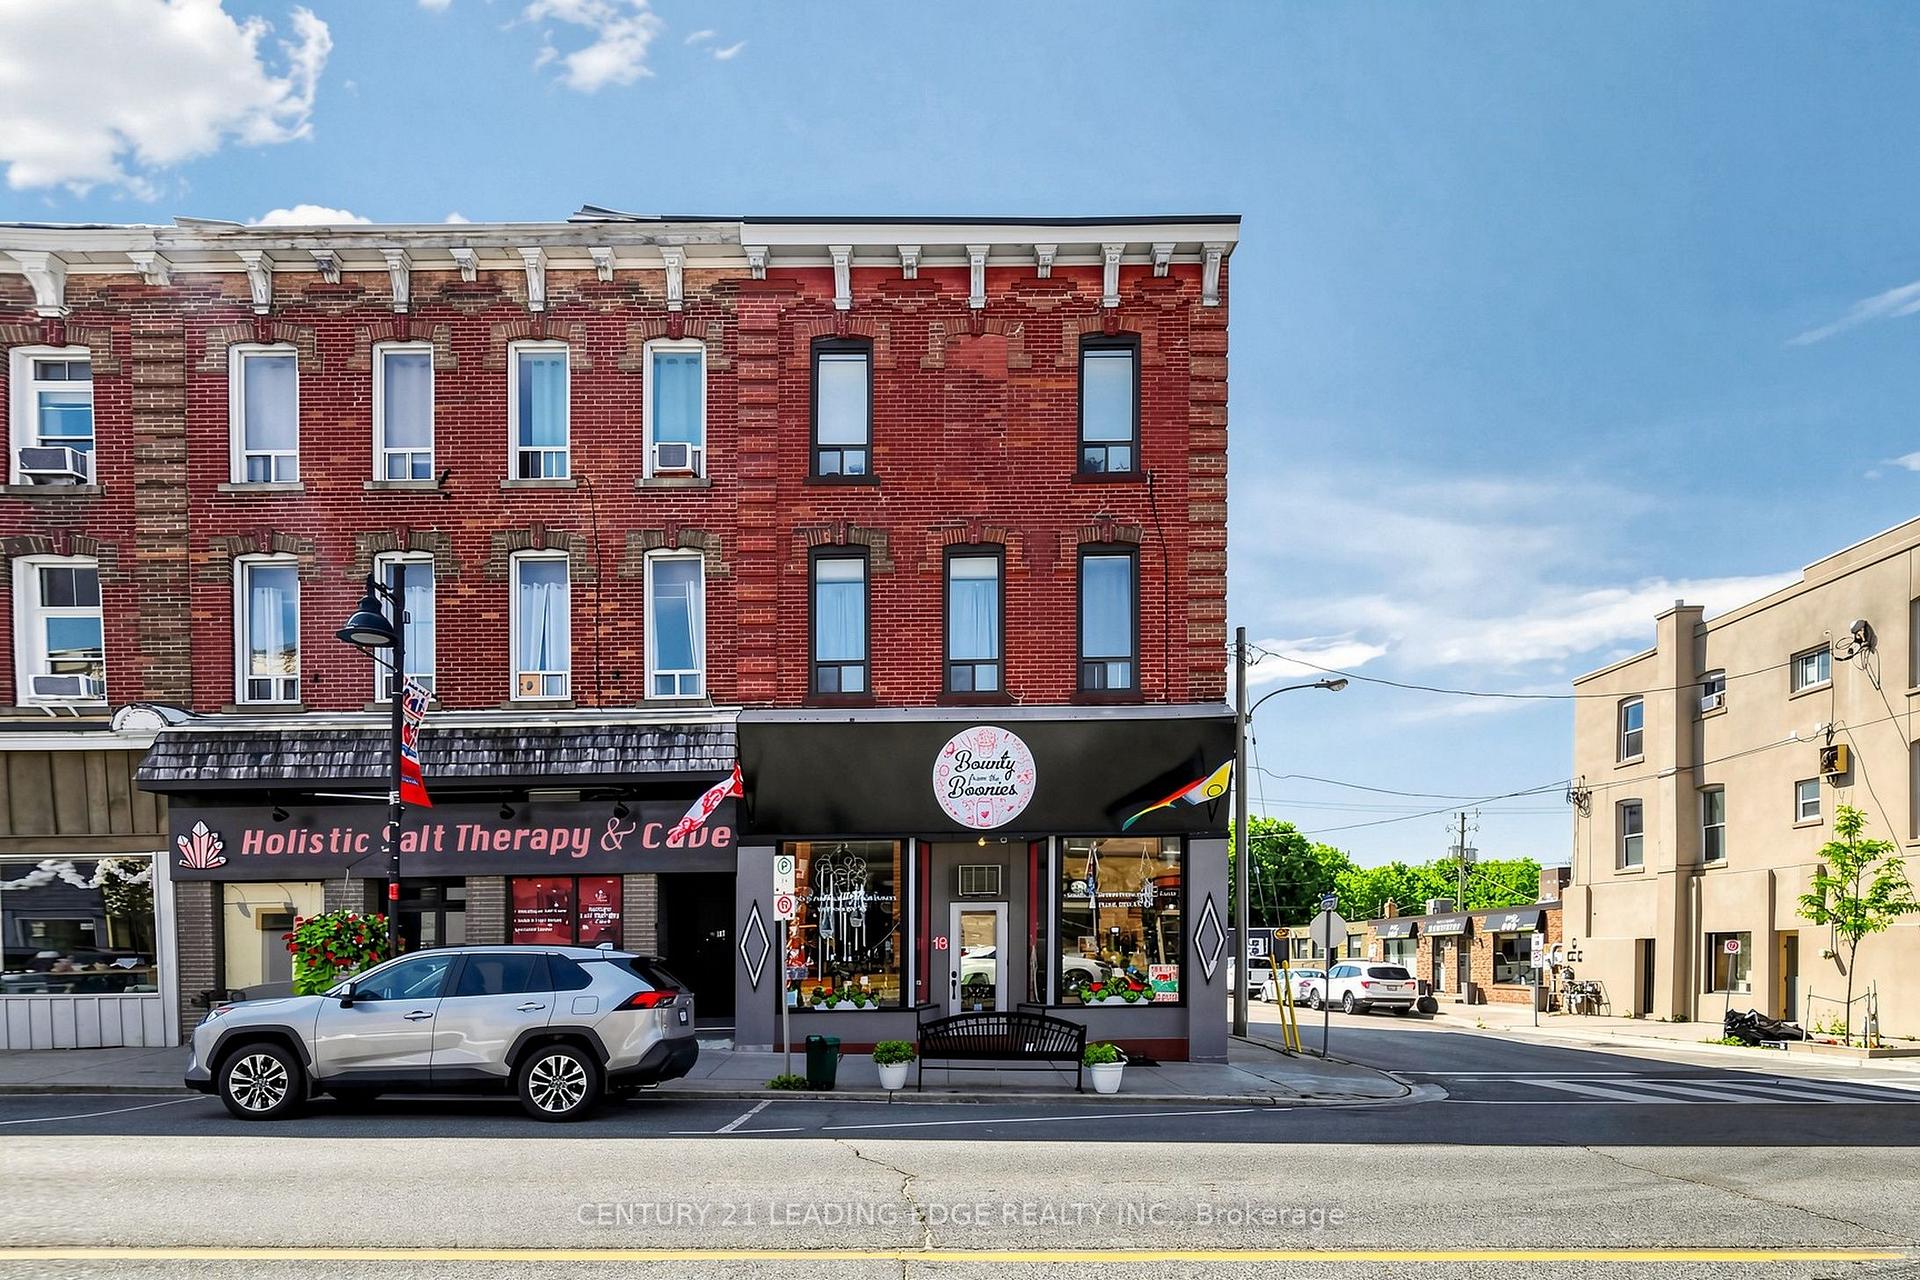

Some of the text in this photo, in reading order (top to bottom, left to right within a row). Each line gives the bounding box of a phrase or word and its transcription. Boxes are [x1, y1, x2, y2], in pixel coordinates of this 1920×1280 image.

[954, 749, 1016, 781] Bounty
[948, 775, 1018, 799] Boonies
[241, 827, 370, 855] Holistic
[455, 824, 592, 858] Therapy
[600, 817, 636, 851] &
